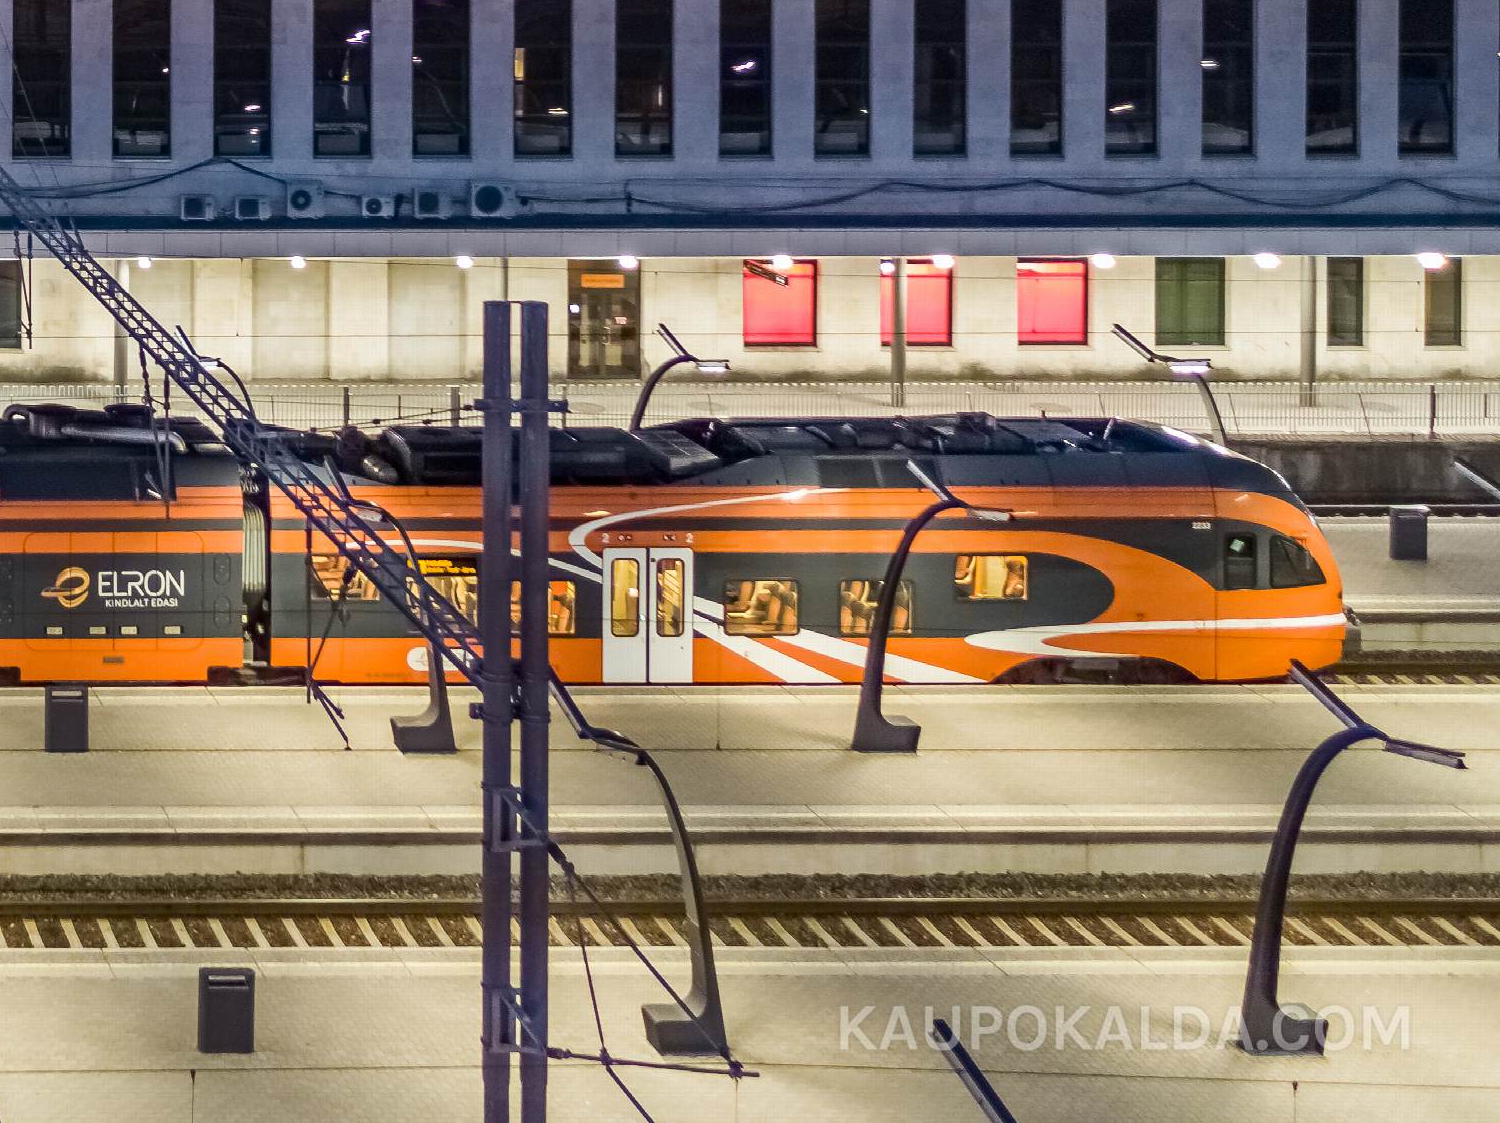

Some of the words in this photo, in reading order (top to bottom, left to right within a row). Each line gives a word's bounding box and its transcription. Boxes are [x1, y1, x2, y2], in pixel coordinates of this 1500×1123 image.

[685, 532, 693, 543] 2
[97, 569, 185, 597] ELRON
[105, 598, 149, 608] KINDLALT
[151, 598, 178, 608] EDASI
